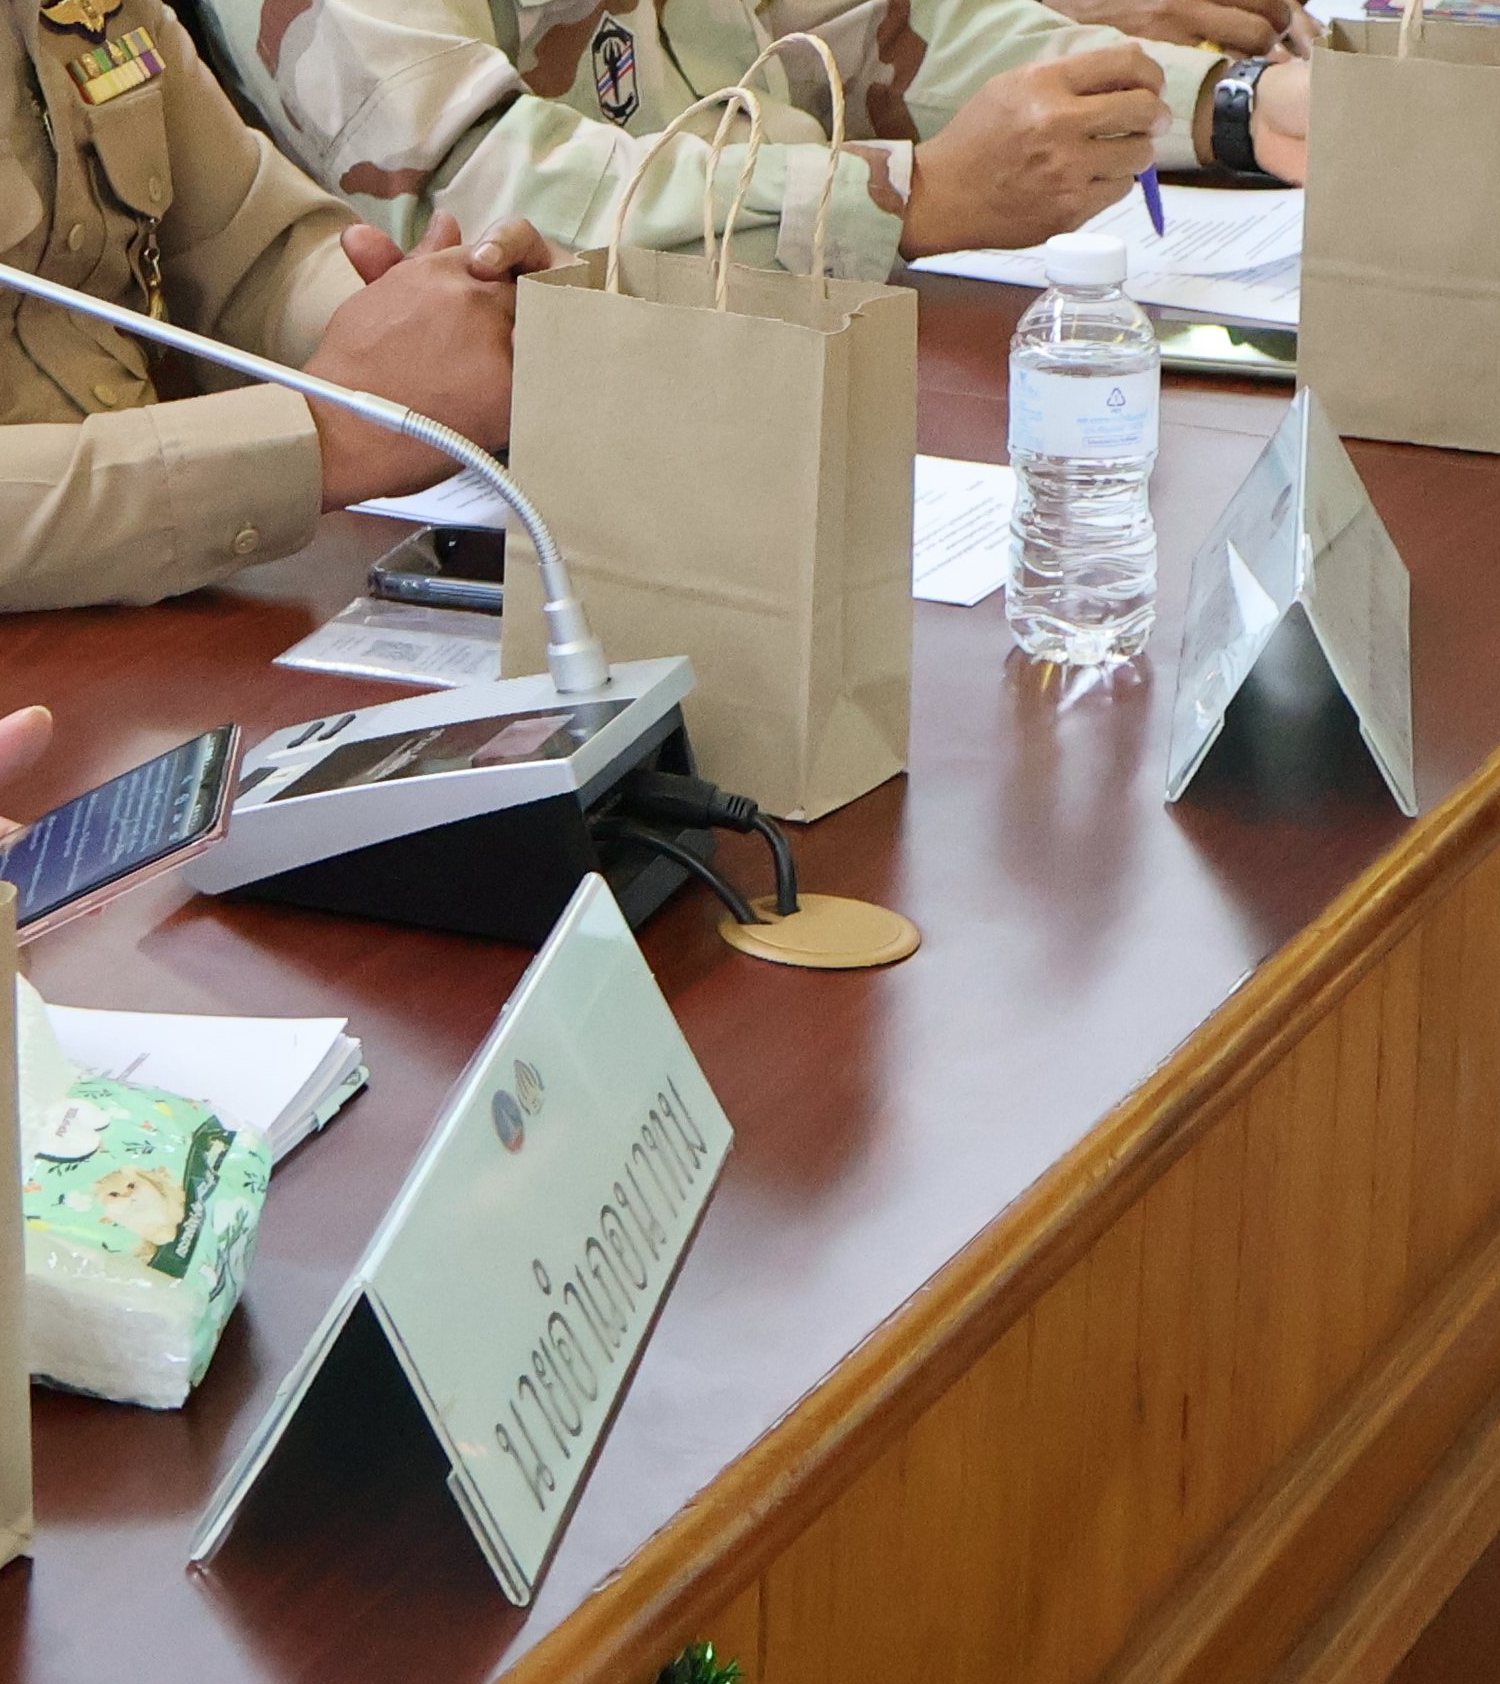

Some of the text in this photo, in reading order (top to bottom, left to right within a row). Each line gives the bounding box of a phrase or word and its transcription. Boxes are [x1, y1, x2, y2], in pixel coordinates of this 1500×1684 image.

[495, 1075, 708, 1511] นายอำเภอนาทม
